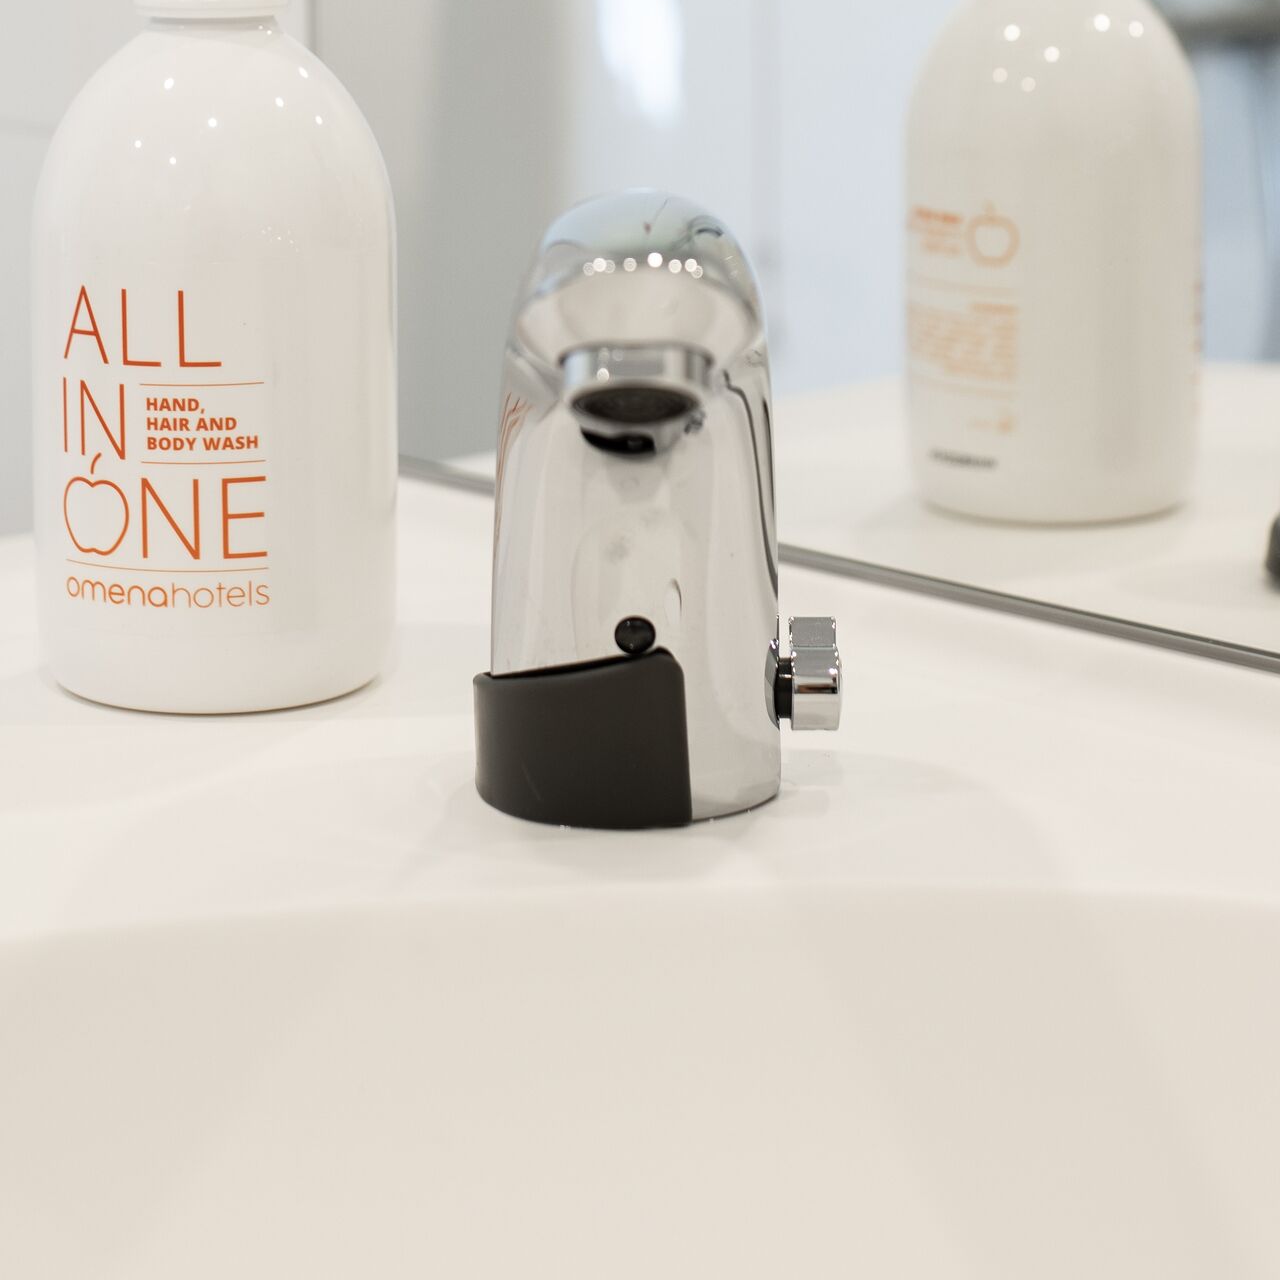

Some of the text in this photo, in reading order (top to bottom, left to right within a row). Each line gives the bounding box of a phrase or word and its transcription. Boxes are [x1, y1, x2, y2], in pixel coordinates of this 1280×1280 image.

[63, 284, 223, 368] ALL
[62, 376, 126, 461] IN
[145, 396, 206, 415] HAND,
[145, 416, 238, 432] HAIR AND
[146, 435, 260, 451] BODY WASH
[63, 474, 269, 561] ONE
[66, 575, 271, 609] omenahotels
